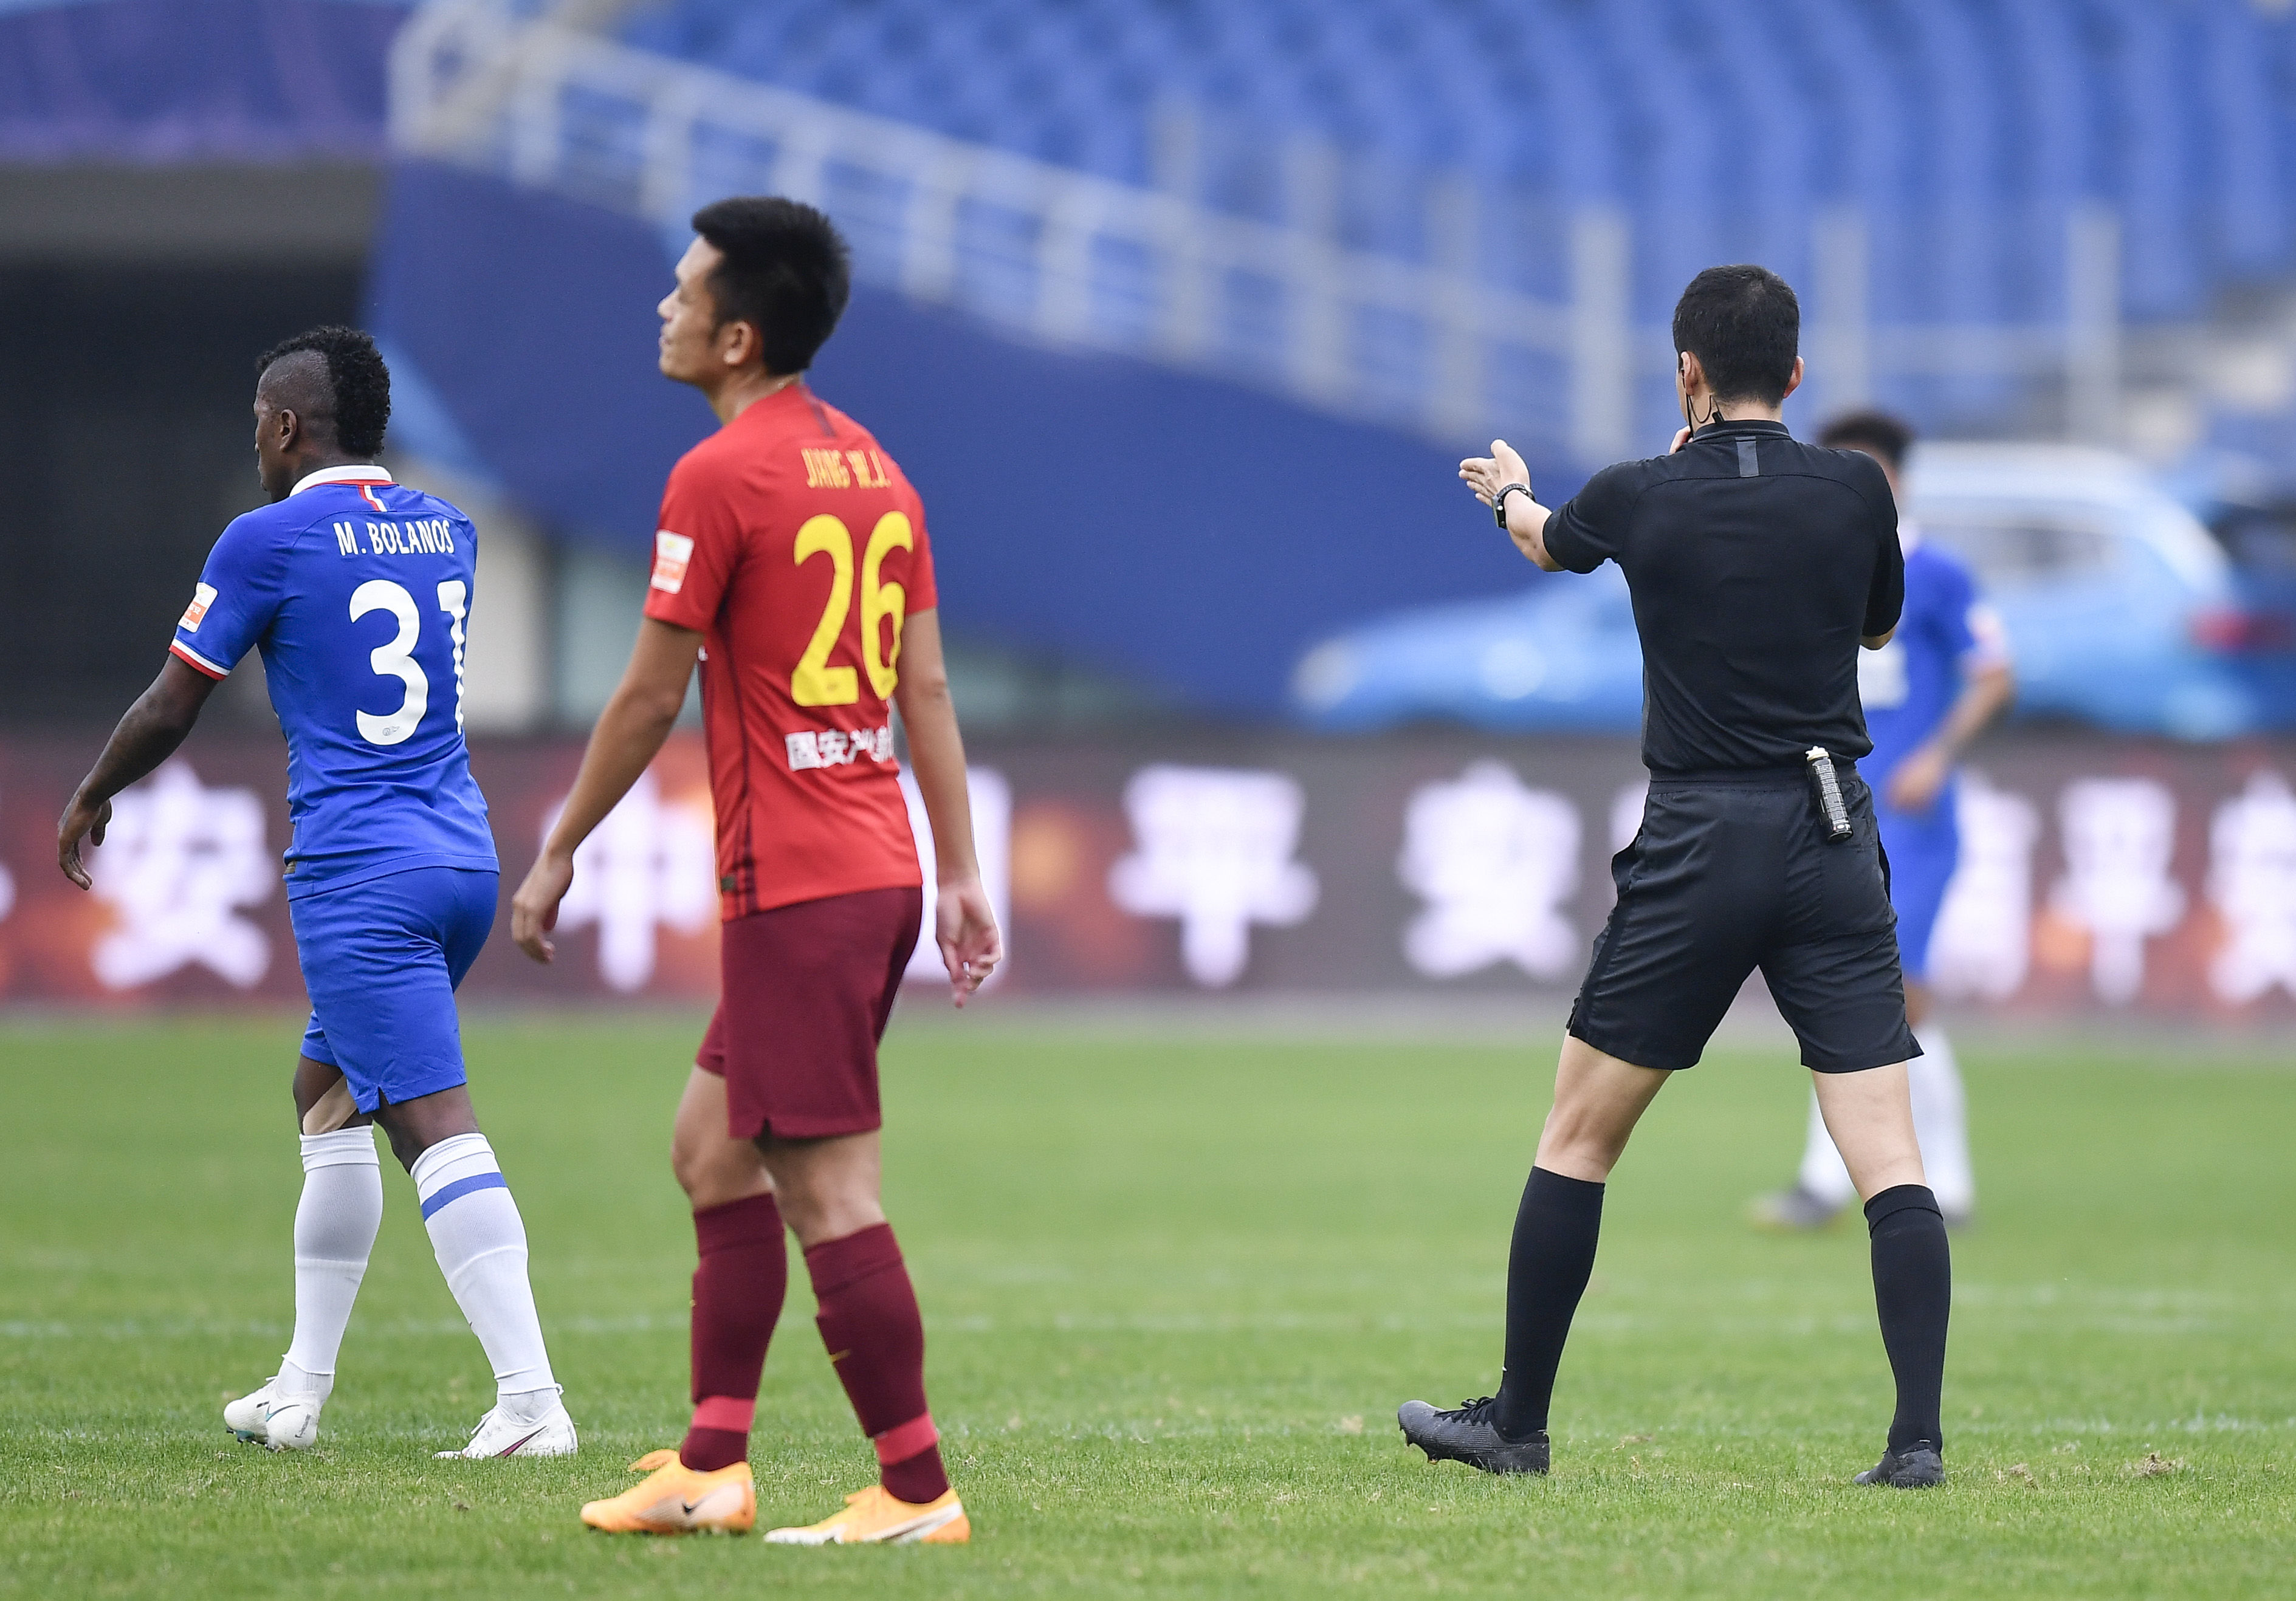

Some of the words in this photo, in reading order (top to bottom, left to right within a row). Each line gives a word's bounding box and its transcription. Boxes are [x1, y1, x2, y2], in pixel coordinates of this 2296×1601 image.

[366, 519, 455, 555] BOLANOS
[791, 510, 913, 707] 26
[349, 579, 467, 746] 31
